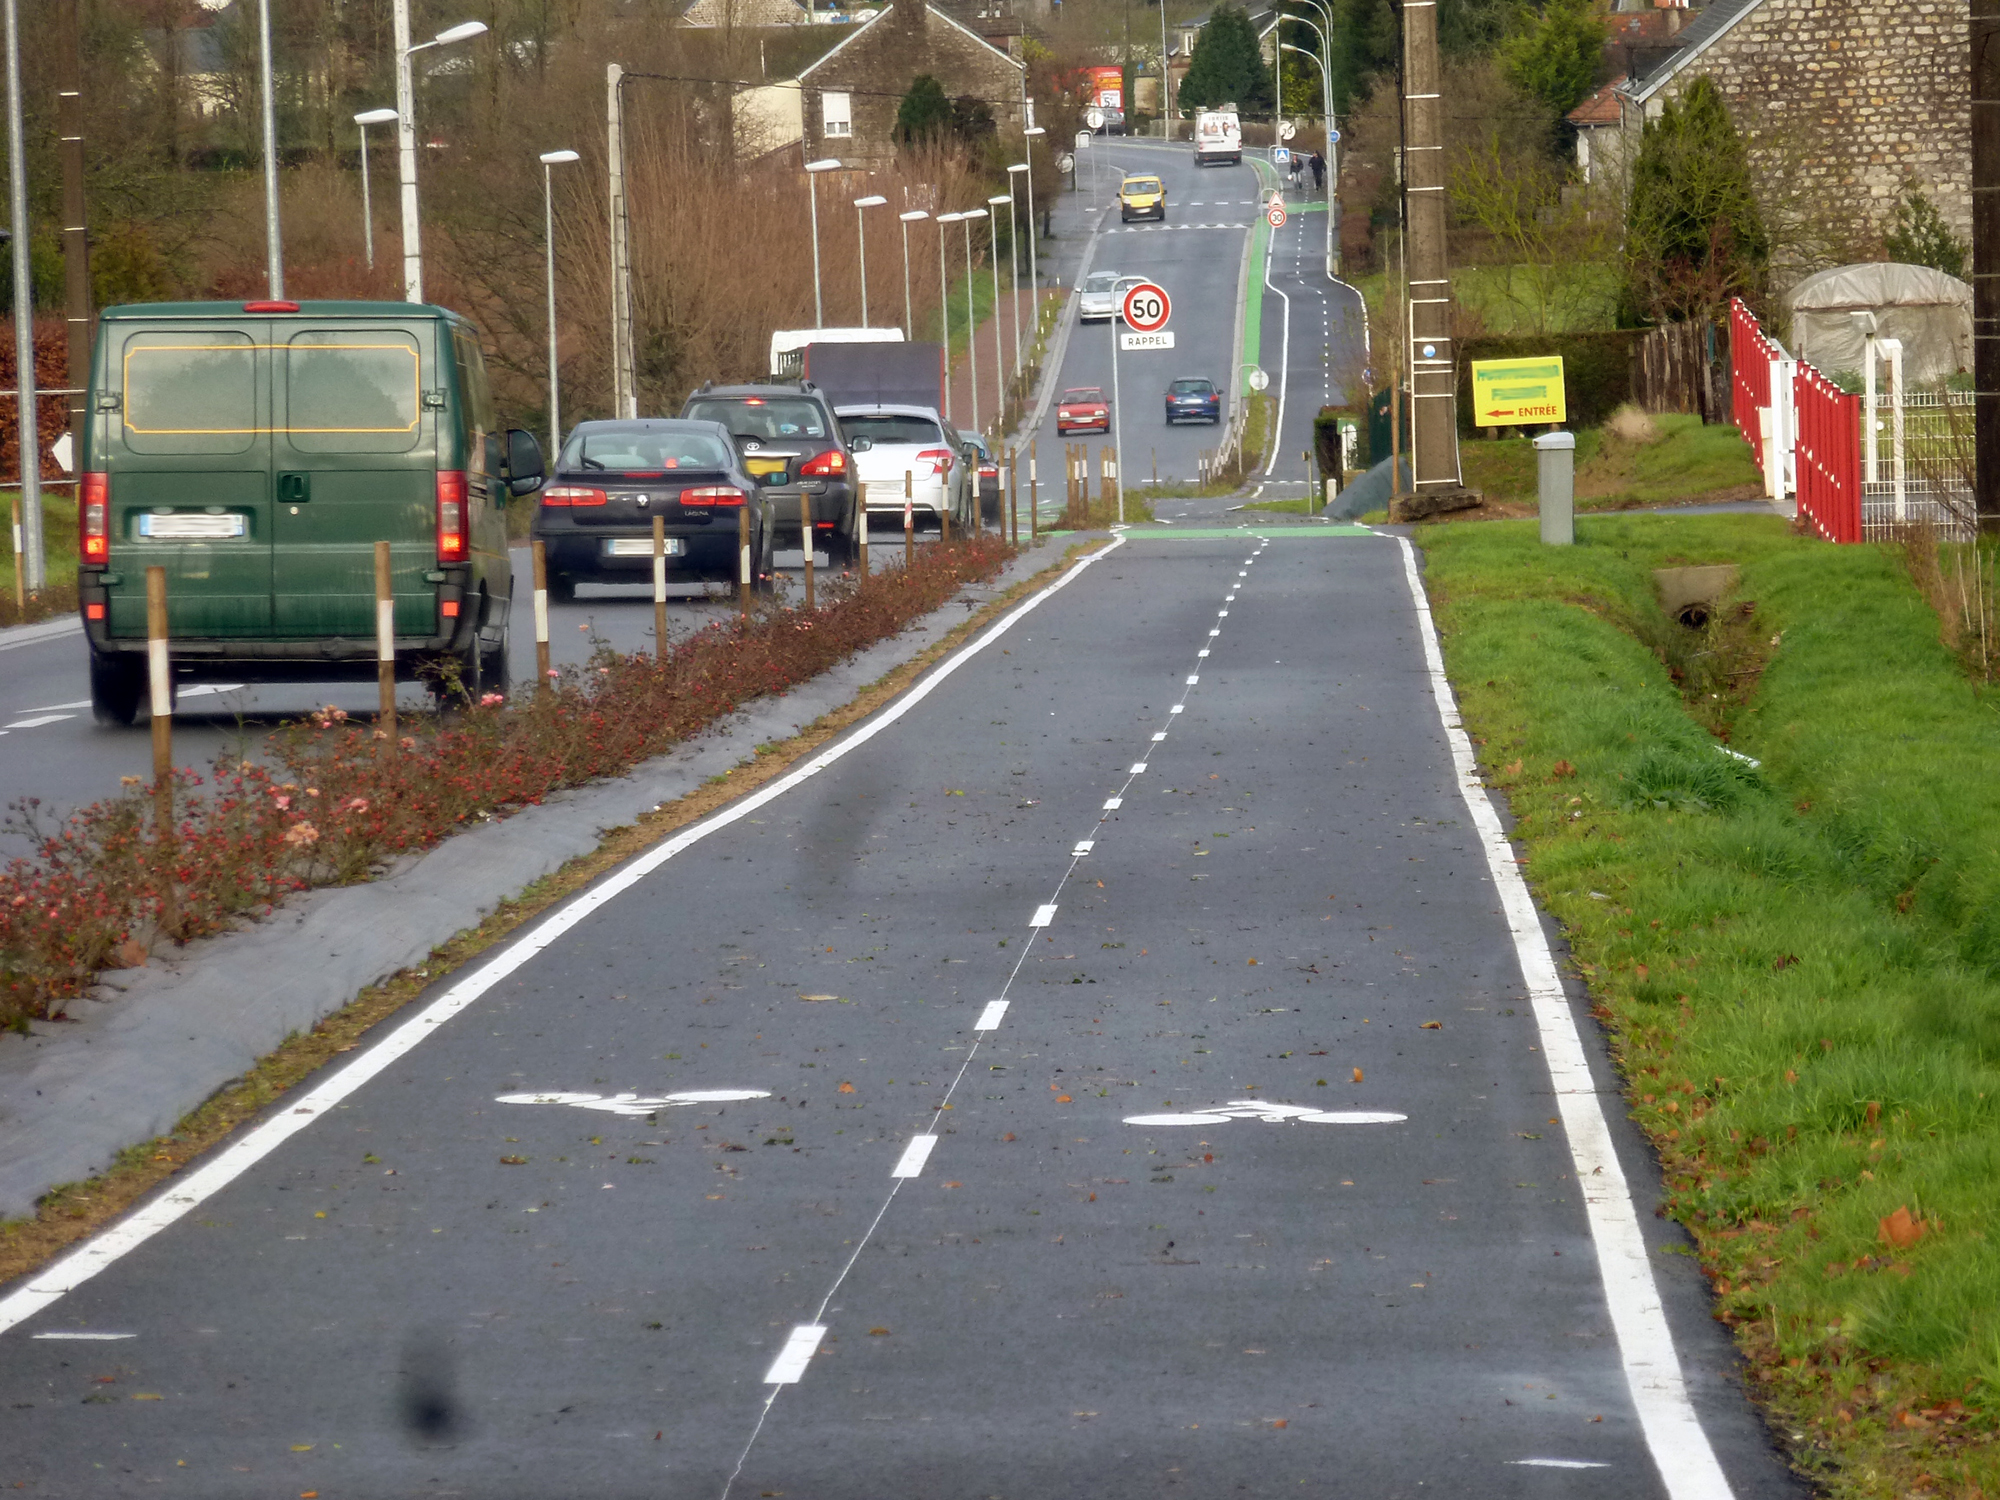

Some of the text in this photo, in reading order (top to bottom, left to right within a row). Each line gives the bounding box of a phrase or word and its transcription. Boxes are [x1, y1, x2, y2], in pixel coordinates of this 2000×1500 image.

[1272, 213, 1282, 222] 30
[1133, 299, 1160, 318] 50
[1128, 336, 1167, 346] RAPPEL
[1518, 404, 1557, 417] ENTRÉE
